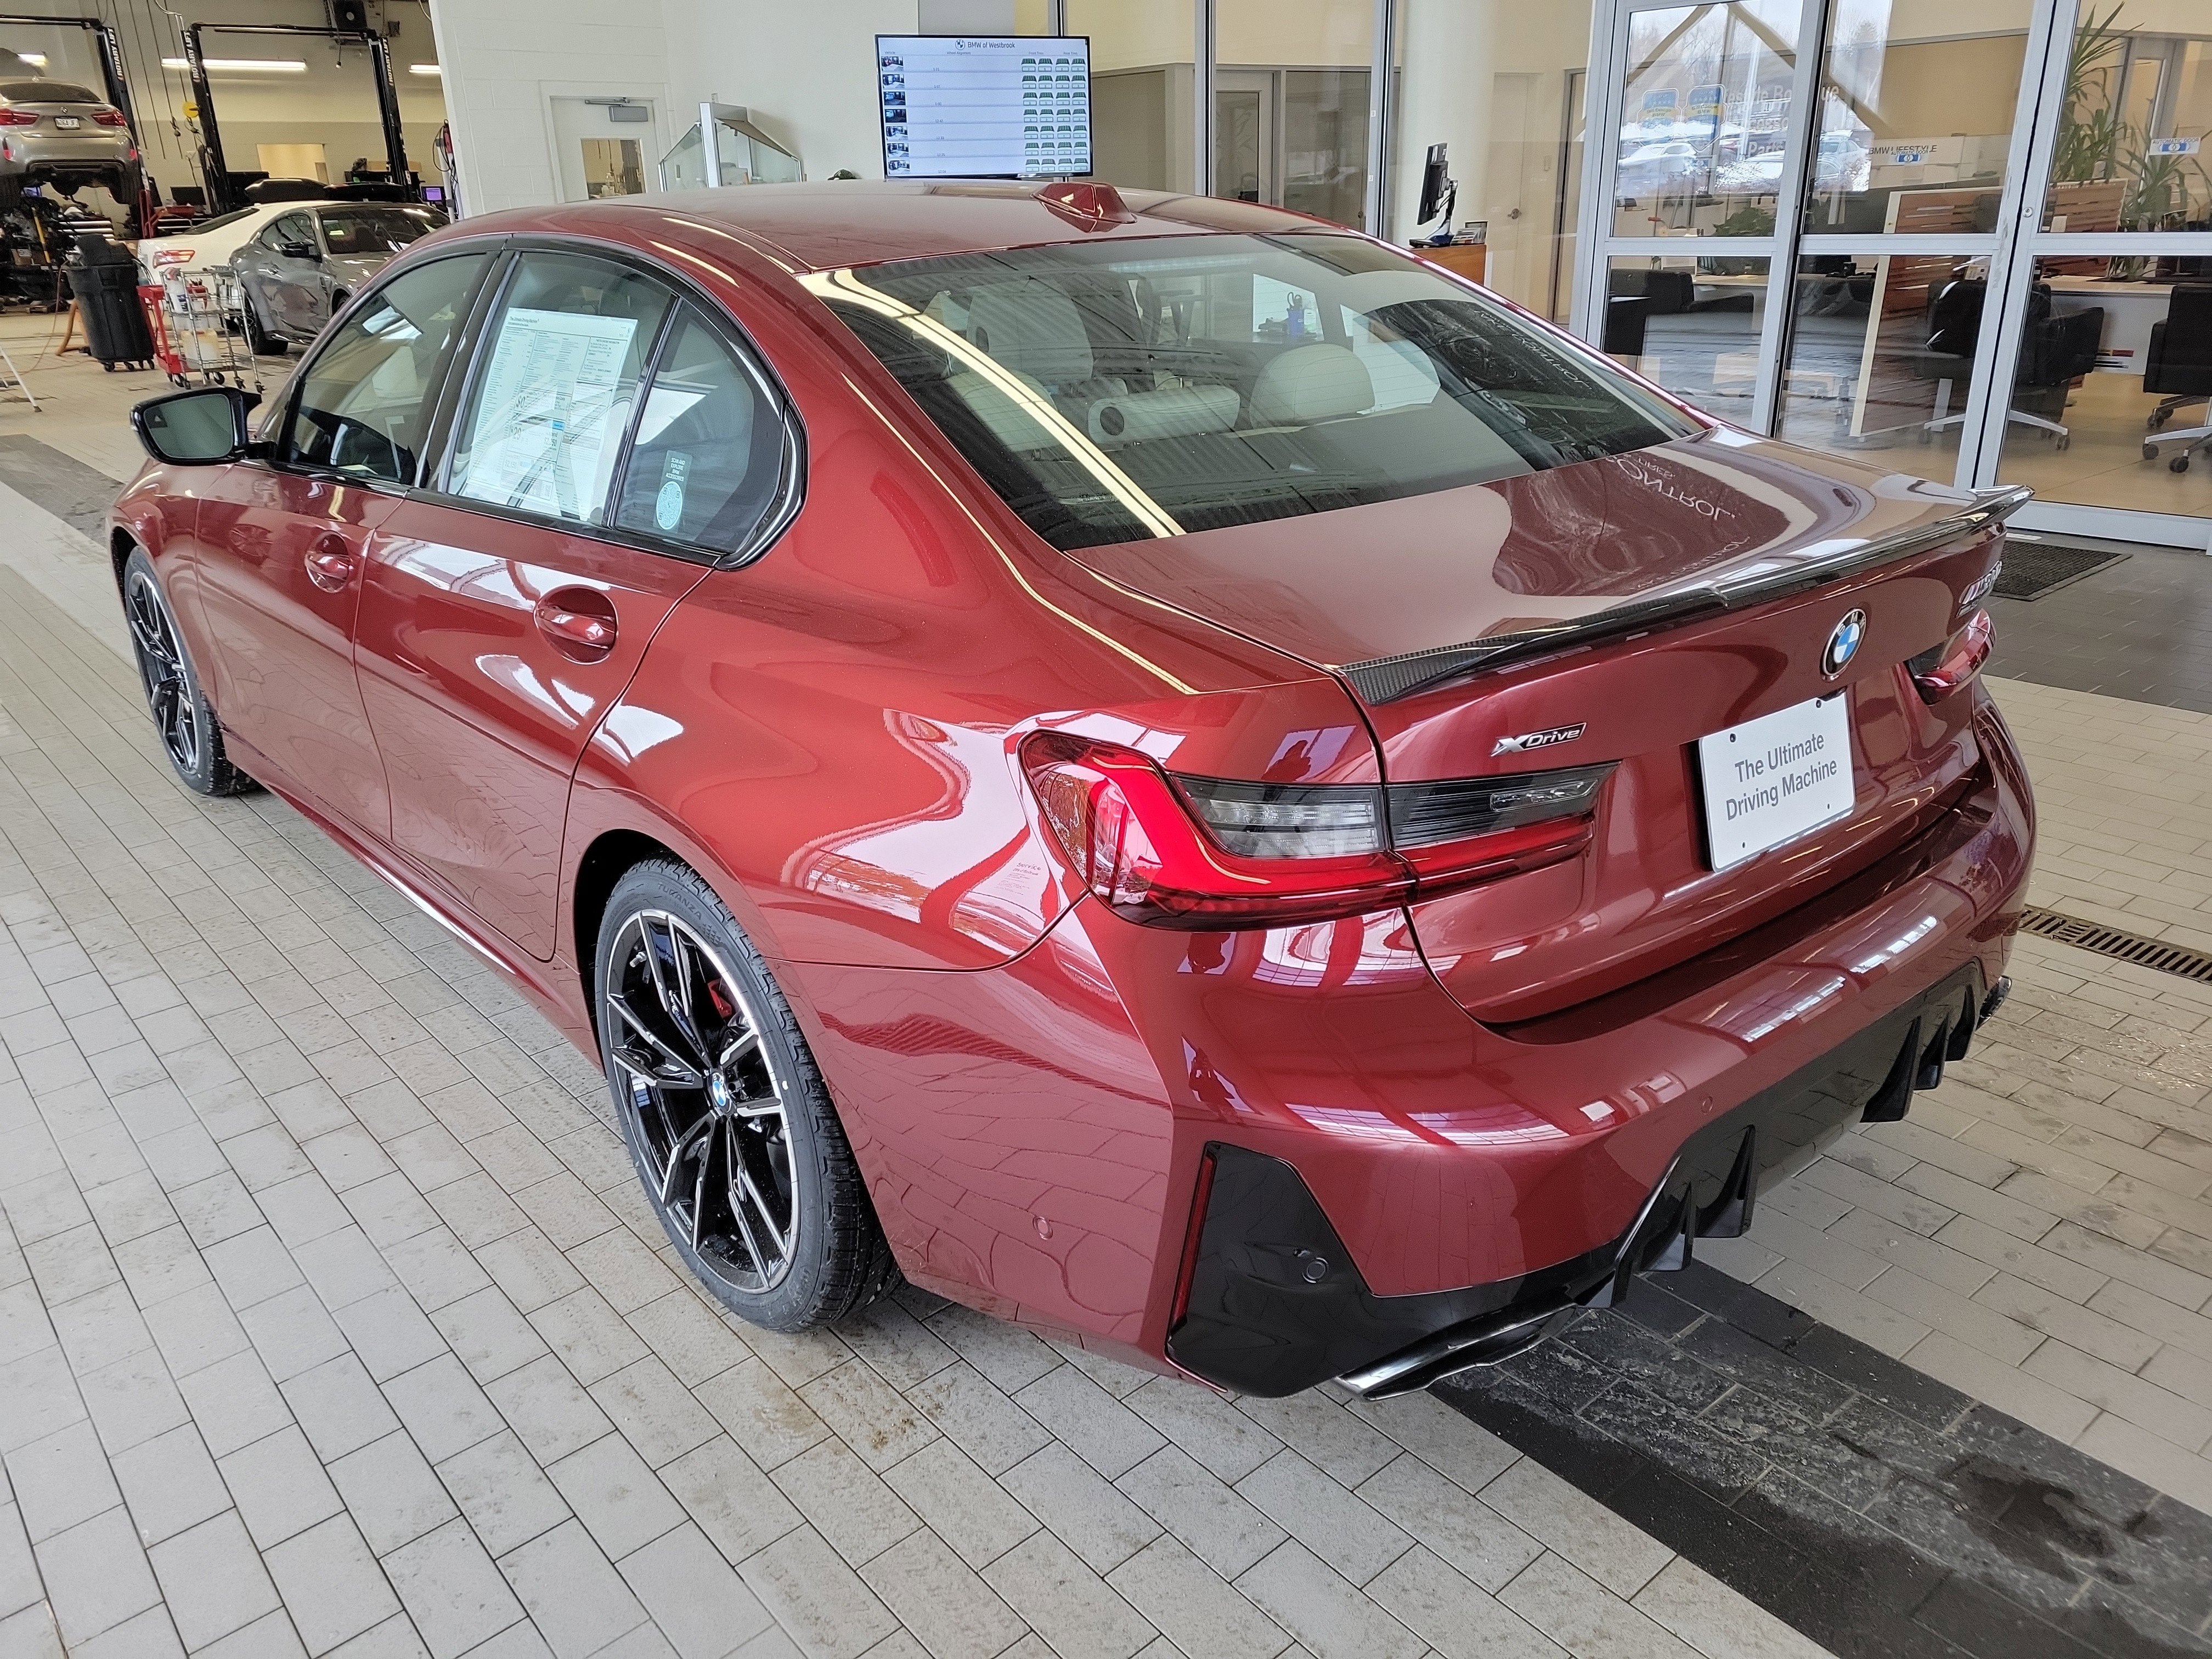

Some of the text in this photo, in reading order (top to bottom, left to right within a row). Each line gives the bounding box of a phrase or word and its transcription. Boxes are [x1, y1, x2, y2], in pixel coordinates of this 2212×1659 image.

[107, 27, 123, 77] ROTARY LIFT
[183, 31, 199, 78] ROTARY LIFT
[385, 54, 393, 82] ROTARY
[1734, 733, 1824, 782] The Ultimate
[1726, 760, 1837, 821] Driving Machine
[658, 883, 702, 921] TURANZA
